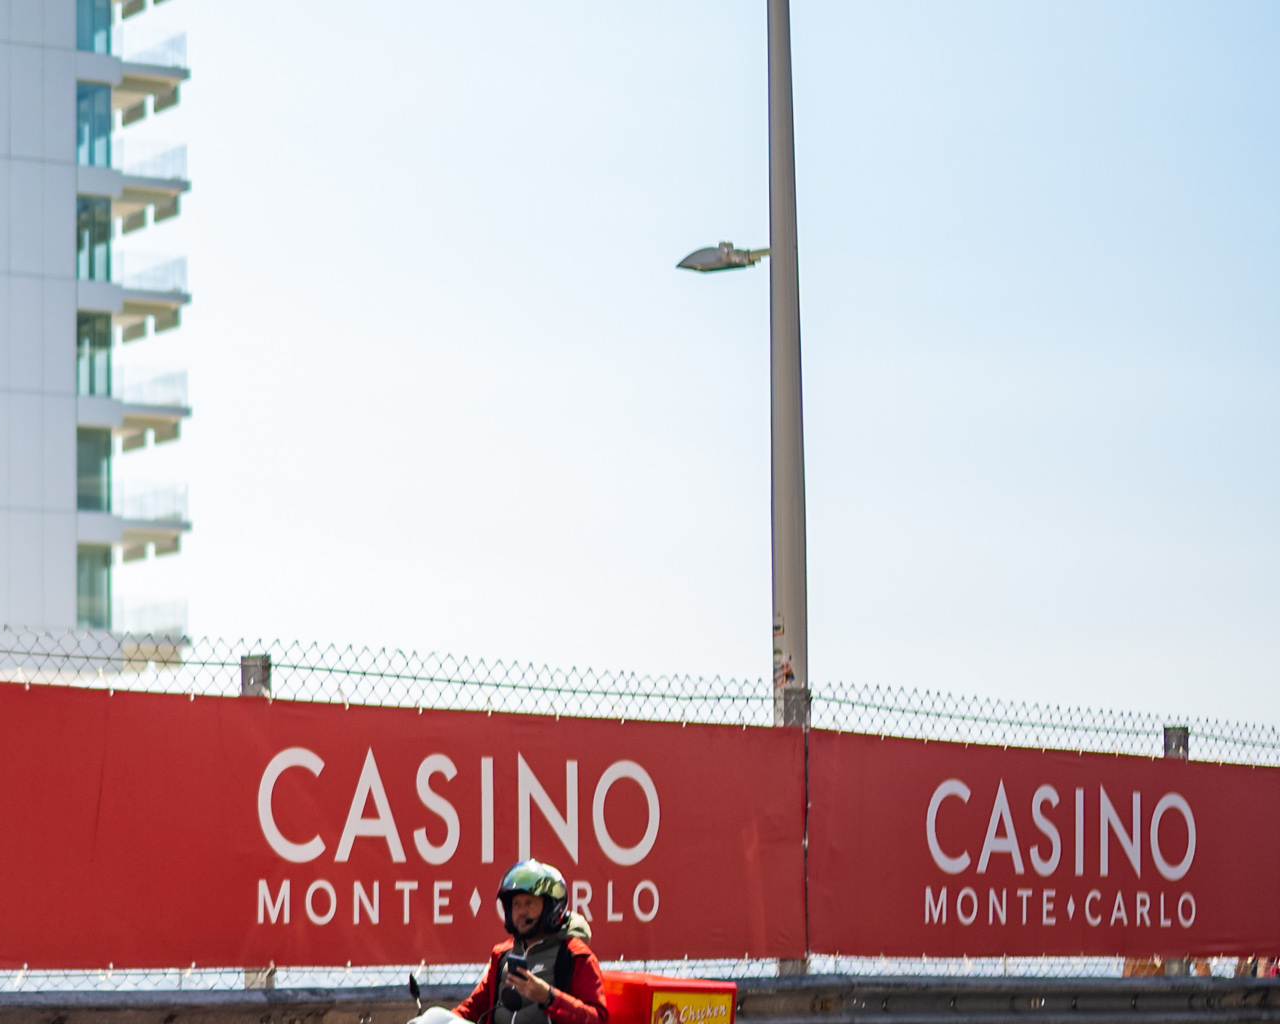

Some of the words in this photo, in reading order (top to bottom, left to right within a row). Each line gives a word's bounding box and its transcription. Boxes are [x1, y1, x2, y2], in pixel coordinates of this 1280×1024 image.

[257, 747, 661, 867] CASINO
[926, 778, 1197, 881] CASINO
[257, 879, 454, 925] MONTE
[496, 880, 660, 923] RLO
[924, 886, 1057, 926] MONTE
[1084, 889, 1197, 928] CARLO
[680, 1002, 727, 1023] Chicken
